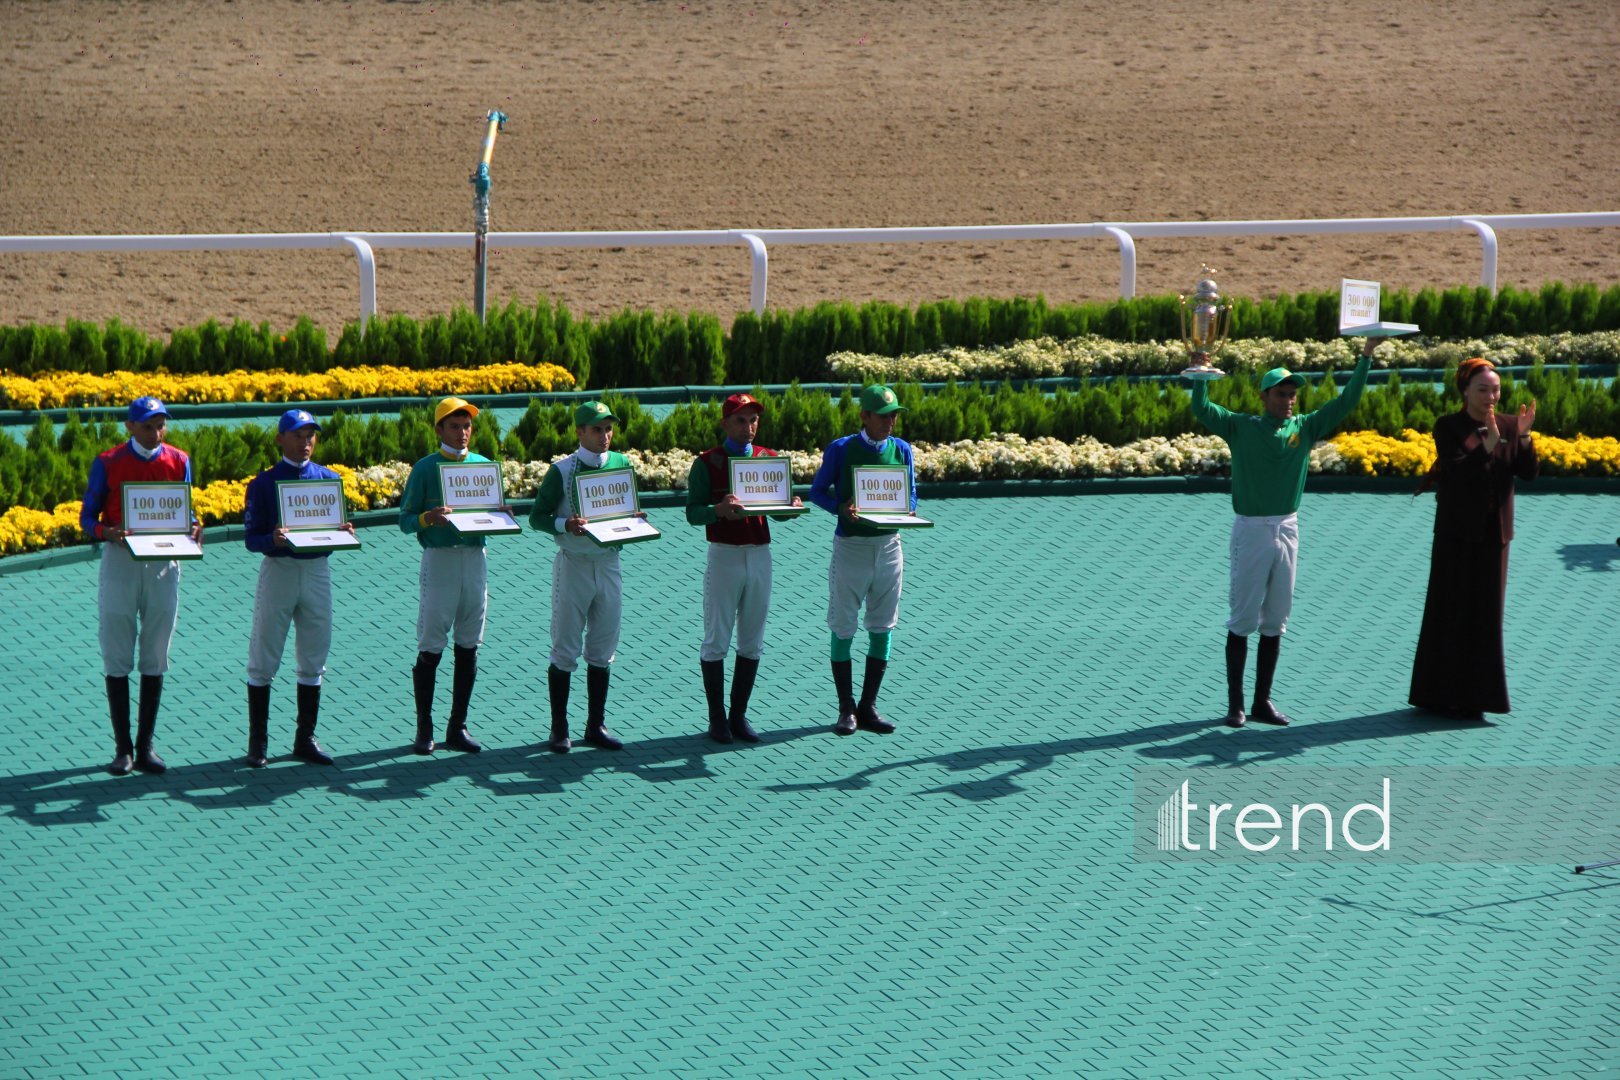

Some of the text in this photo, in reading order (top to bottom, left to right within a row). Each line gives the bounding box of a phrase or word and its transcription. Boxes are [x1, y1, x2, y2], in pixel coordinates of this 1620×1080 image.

[1347, 294, 1375, 307] 300 000
[1350, 309, 1371, 318] manat
[448, 475, 494, 488] 100 000
[738, 470, 783, 483] 100 000
[585, 481, 629, 498] 100 000
[744, 484, 779, 493] manat
[861, 479, 902, 491] 100 000
[455, 488, 490, 498] manat
[866, 492, 898, 501] manat
[132, 497, 182, 509] 100 000
[288, 494, 336, 507] 100 000
[591, 496, 625, 508] manat
[138, 511, 176, 520] manat
[294, 507, 331, 518] manat
